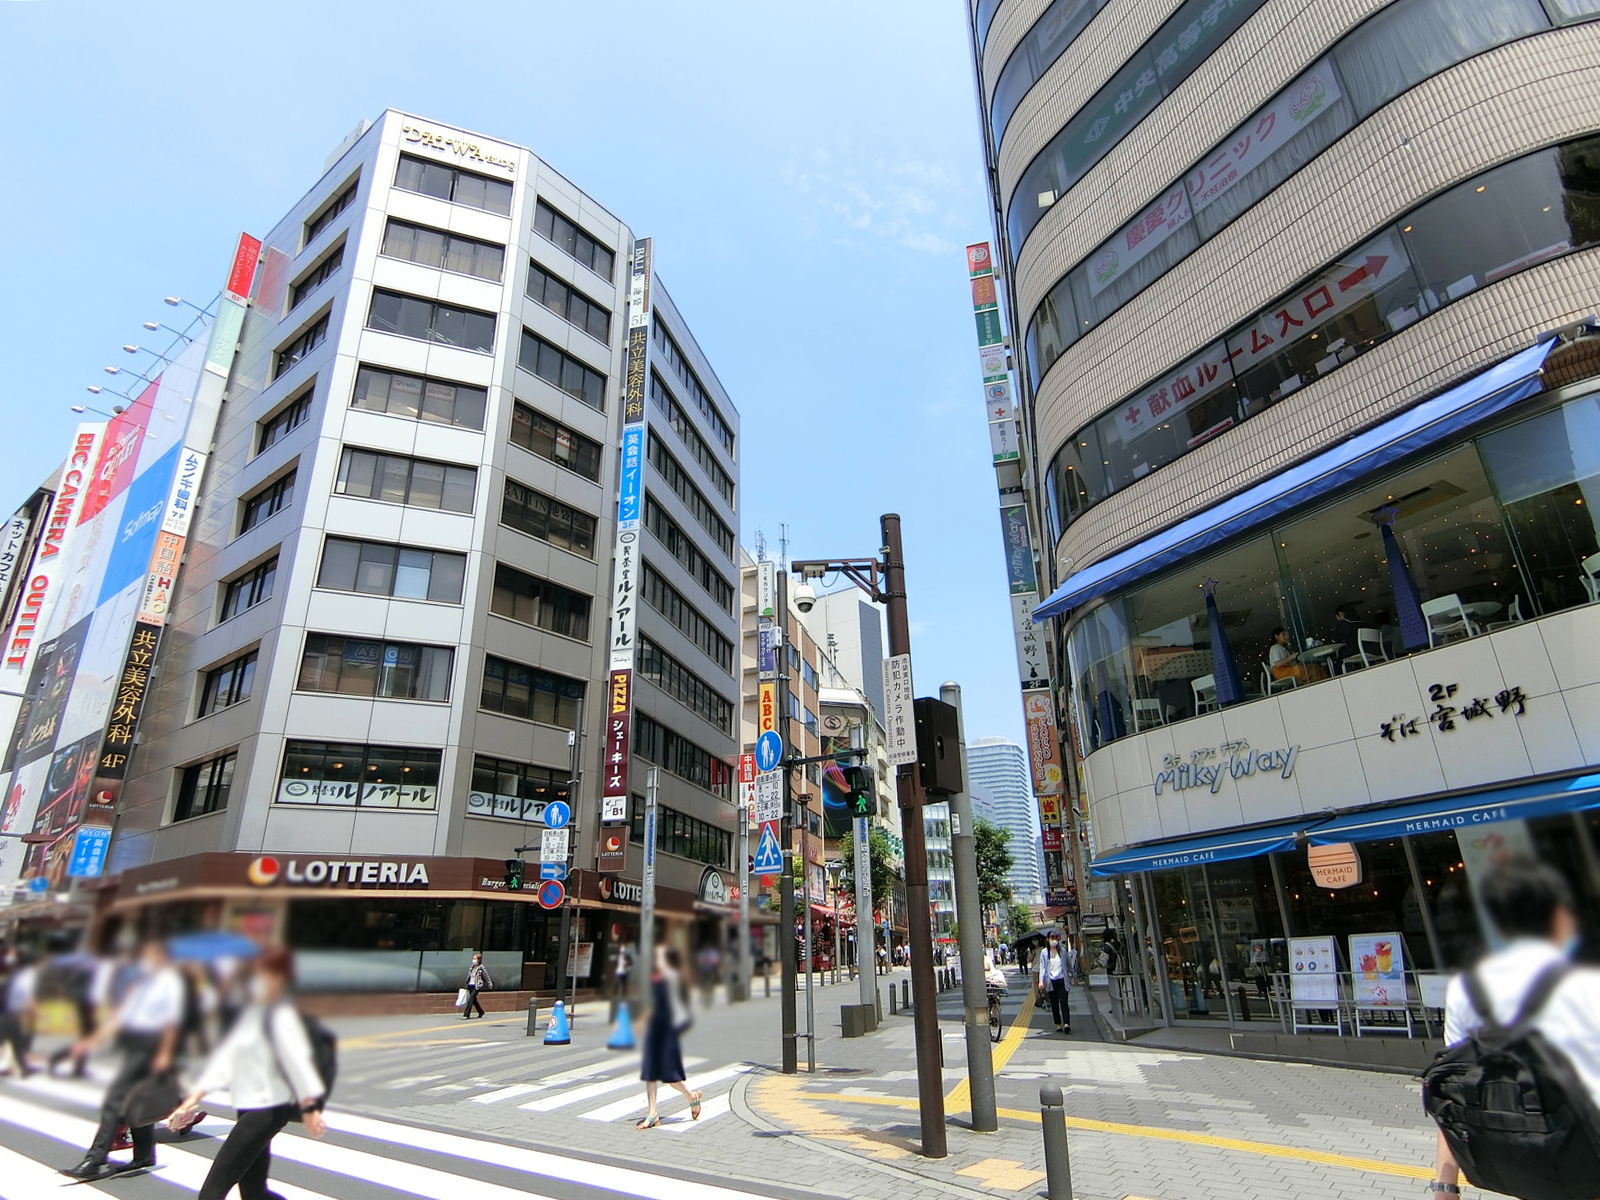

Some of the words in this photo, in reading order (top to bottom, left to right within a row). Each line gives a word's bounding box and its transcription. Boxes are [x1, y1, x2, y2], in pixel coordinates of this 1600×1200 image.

[631, 314, 647, 326] 5F
[627, 331, 645, 417] 共立美容外科
[70, 433, 95, 465] BIC
[624, 433, 639, 519] 英会話イーオン
[41, 469, 83, 558] CAMERA
[622, 521, 635, 529] 3F
[155, 535, 179, 577] 中国語
[6, 574, 49, 668] OUTLET
[106, 629, 157, 745] 共立美容外科
[613, 674, 627, 714] PIZZA
[1428, 683, 1458, 701] 2F
[762, 690, 772, 731] ABC
[891, 659, 906, 748] 防犯カメラ作動中
[101, 753, 127, 768] 4F
[609, 719, 623, 788] シェーキーズ
[1163, 753, 1181, 769] 2F
[1155, 761, 1228, 795] Milky
[1229, 744, 1300, 779] Way
[771, 791, 779, 800] 22
[612, 807, 623, 816] B1
[771, 810, 778, 818] 22
[1406, 816, 1465, 832] MERMAID
[1152, 856, 1189, 867] MERMAID
[1193, 851, 1215, 861] CAFÉ
[287, 860, 429, 886] LOTTERIA
[1316, 866, 1353, 877] MERMAID
[1326, 875, 1347, 884] CAFÉ
[481, 877, 506, 890] Burger
[613, 881, 642, 901] LOTTE
